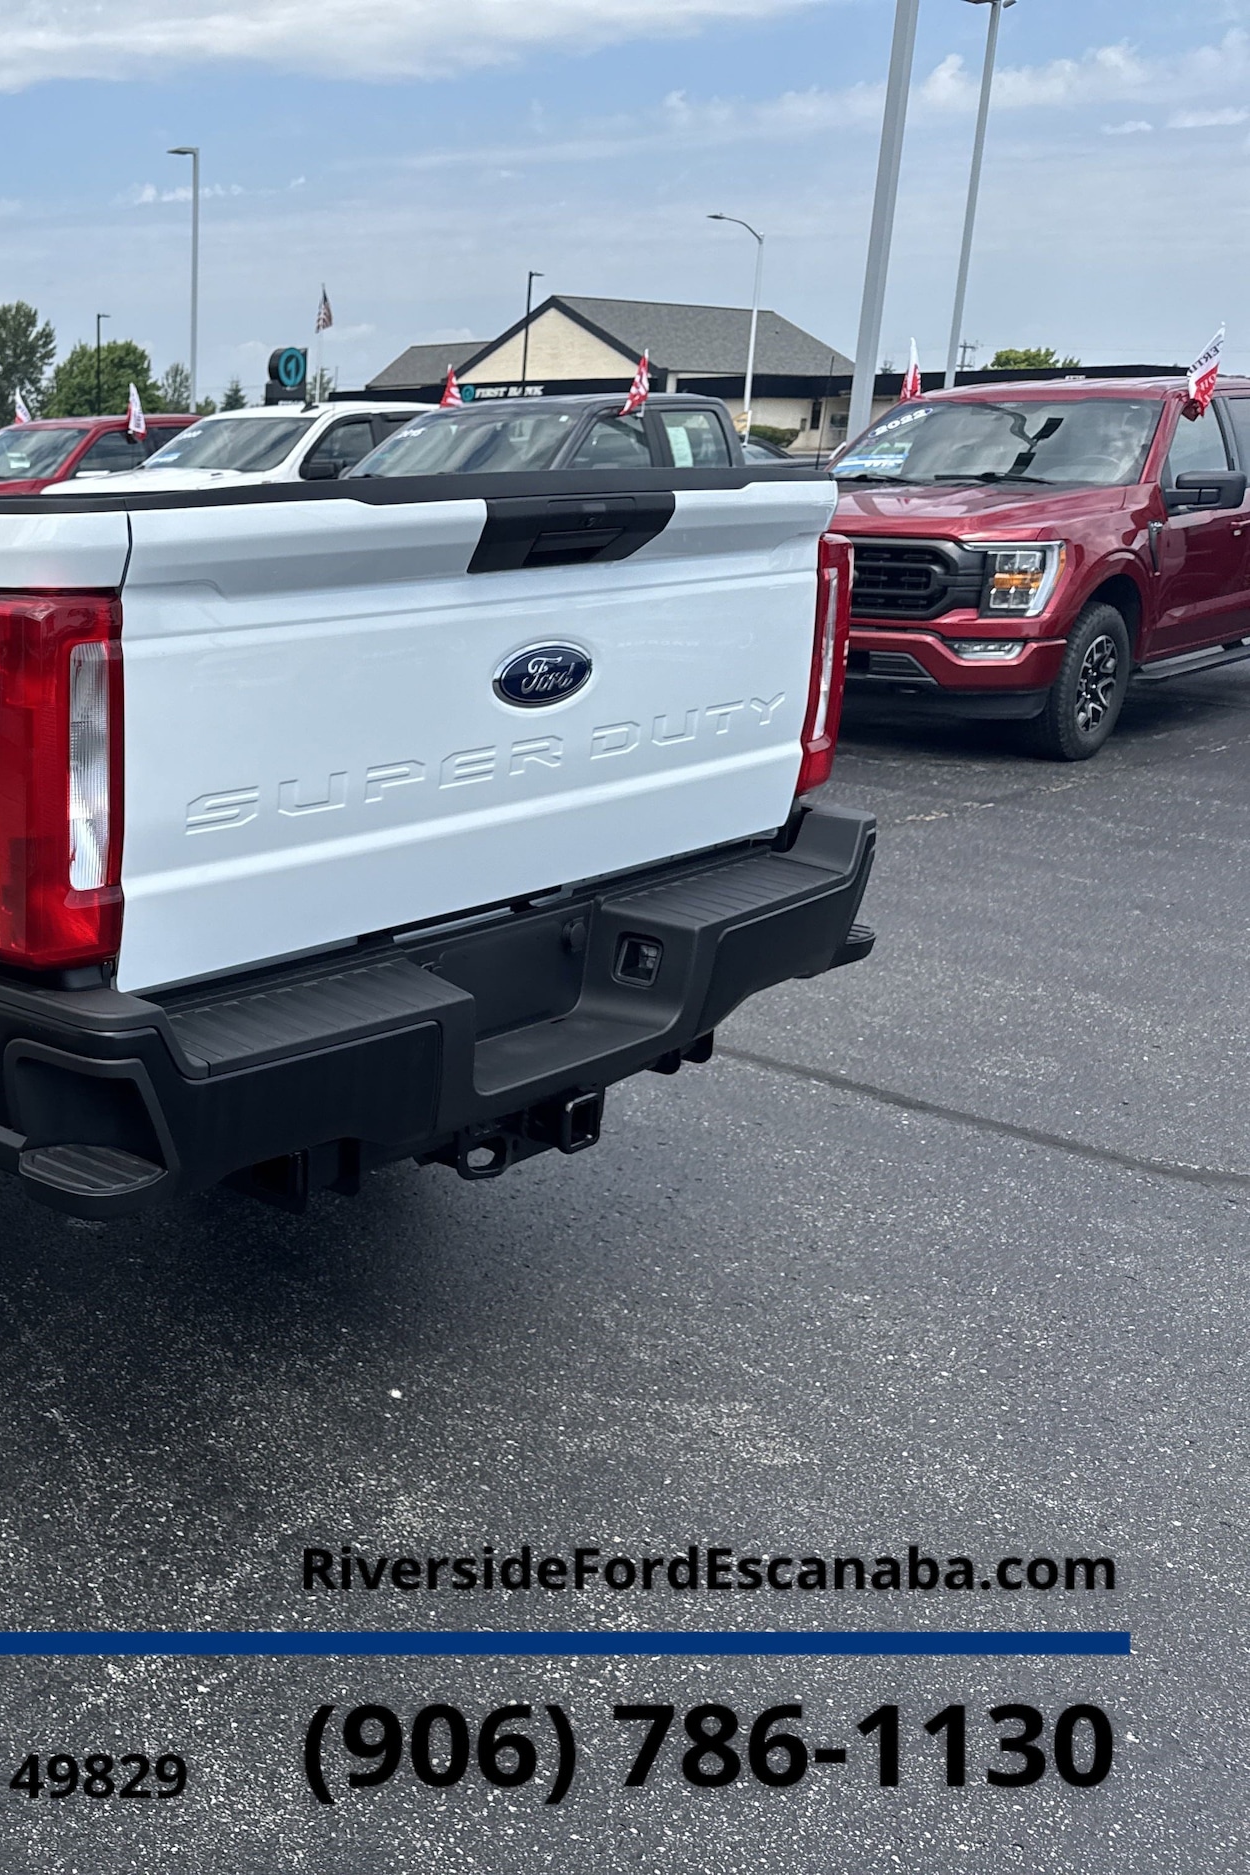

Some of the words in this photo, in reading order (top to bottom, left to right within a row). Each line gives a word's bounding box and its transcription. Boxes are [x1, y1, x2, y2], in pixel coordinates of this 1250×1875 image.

[872, 408, 928, 436] 2022
[520, 655, 576, 696] Ford
[185, 735, 564, 835] SUPER
[590, 691, 786, 760] DUTY
